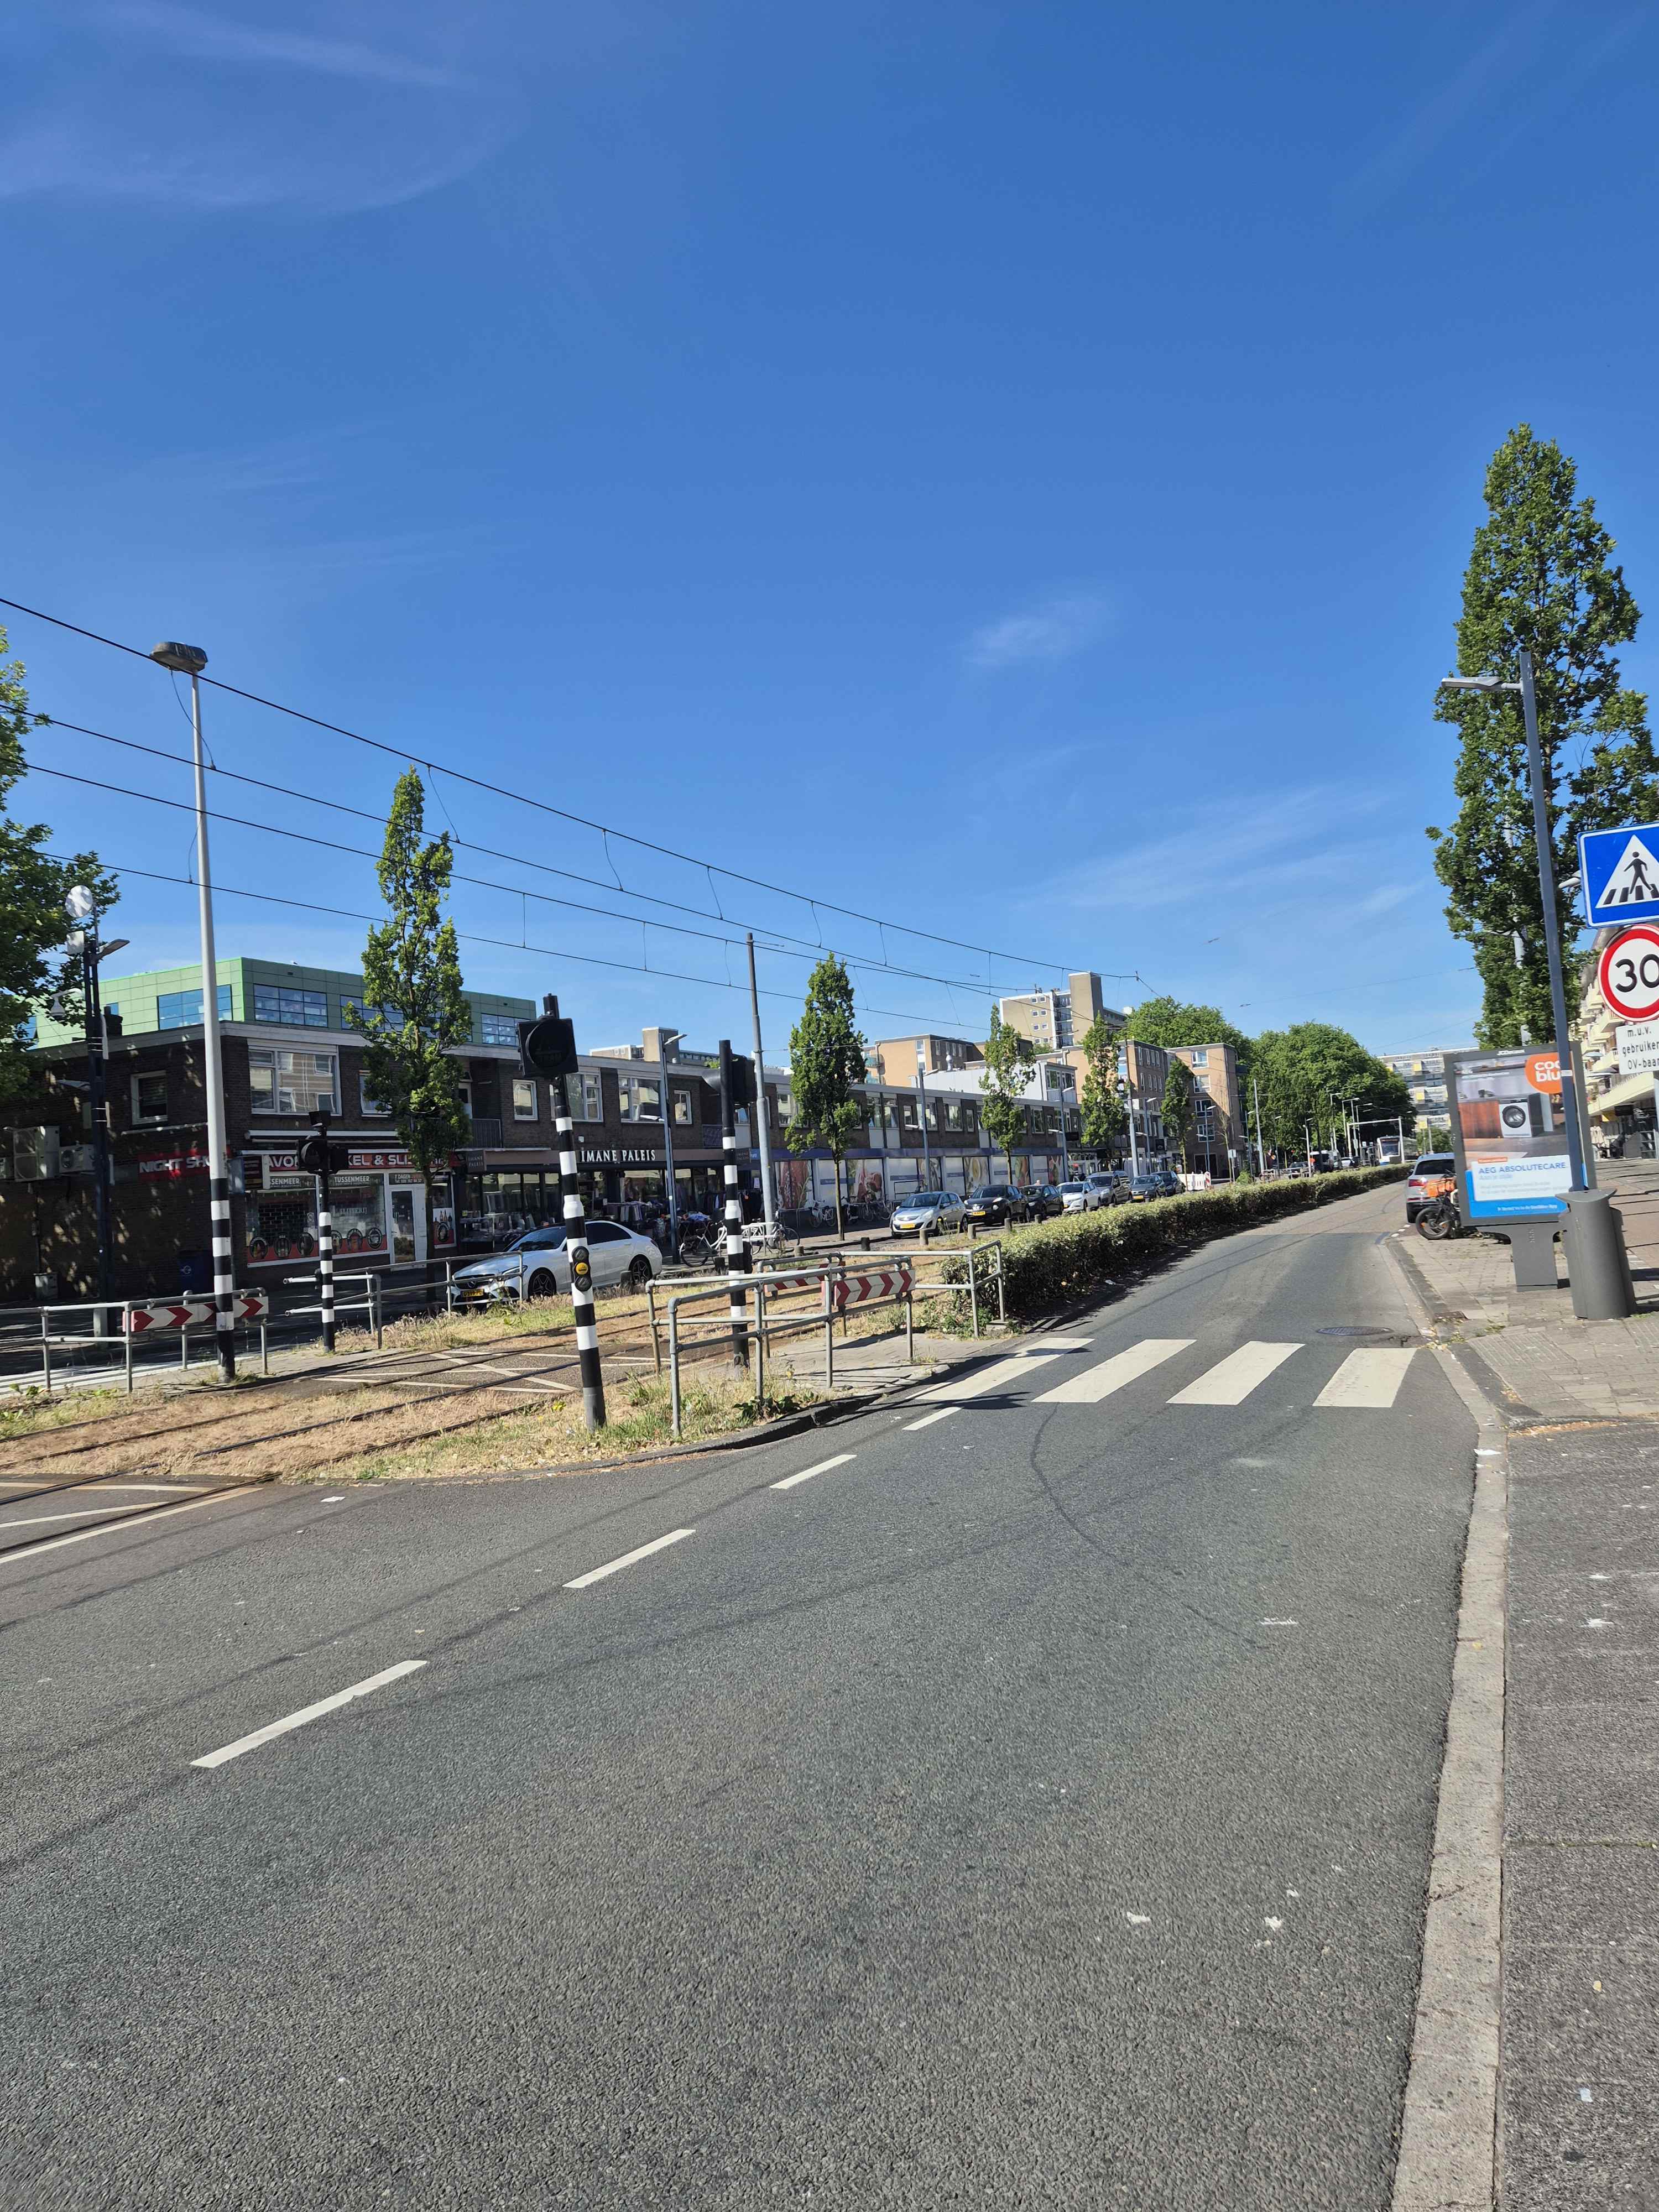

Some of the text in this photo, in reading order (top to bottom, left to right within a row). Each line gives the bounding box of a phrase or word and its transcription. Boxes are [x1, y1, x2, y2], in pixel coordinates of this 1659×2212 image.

[1615, 954, 1659, 993] 30
[1627, 1026, 1651, 1037] m.u.v.
[374, 1155, 384, 1165] &
[581, 1149, 655, 1162] IMANE PALEIS
[139, 1159, 183, 1173] NIGHT
[1499, 1162, 1566, 1173] ABSOLUTECARE
